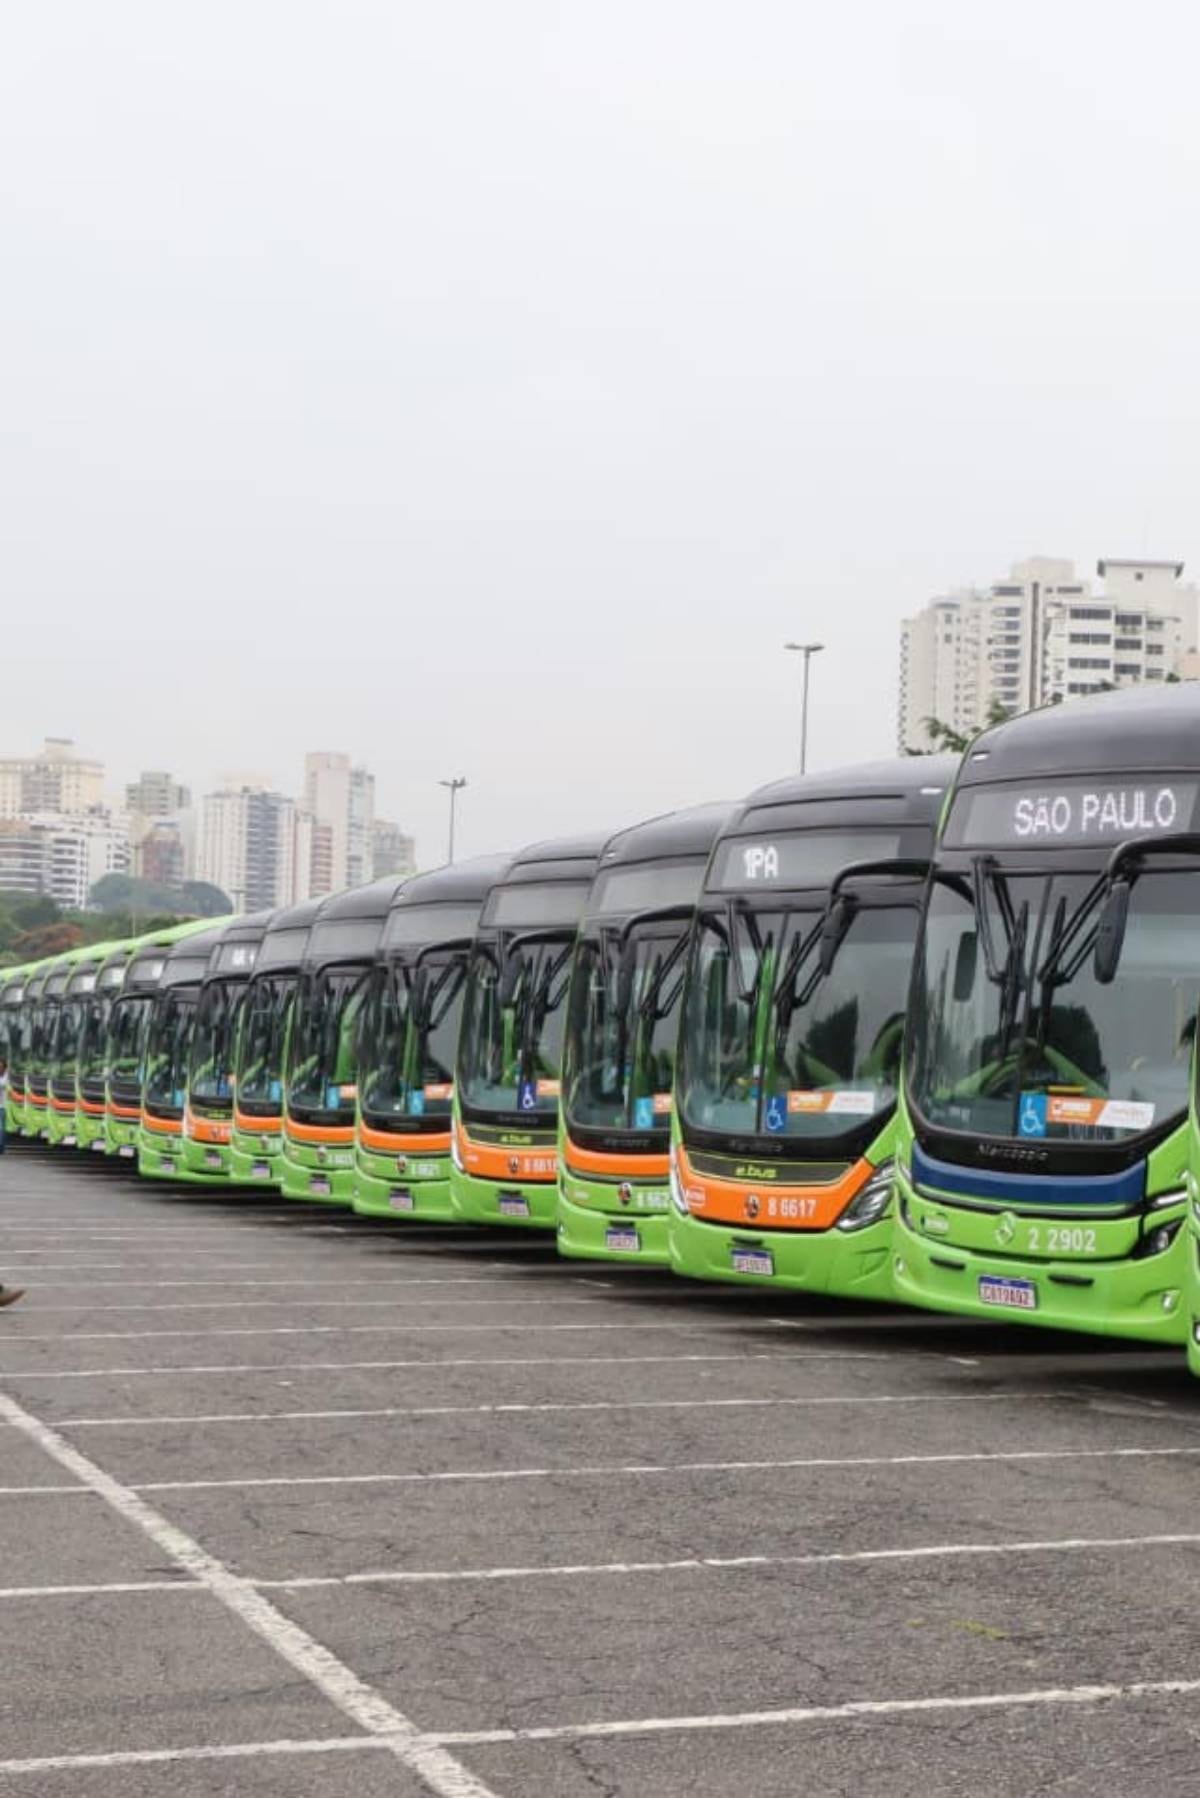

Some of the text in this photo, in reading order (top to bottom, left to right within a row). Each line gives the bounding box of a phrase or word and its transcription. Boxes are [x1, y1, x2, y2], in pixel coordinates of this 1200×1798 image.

[1014, 787, 1177, 836] SÃO PAULO
[1028, 1228, 1097, 1253] 2 2902
